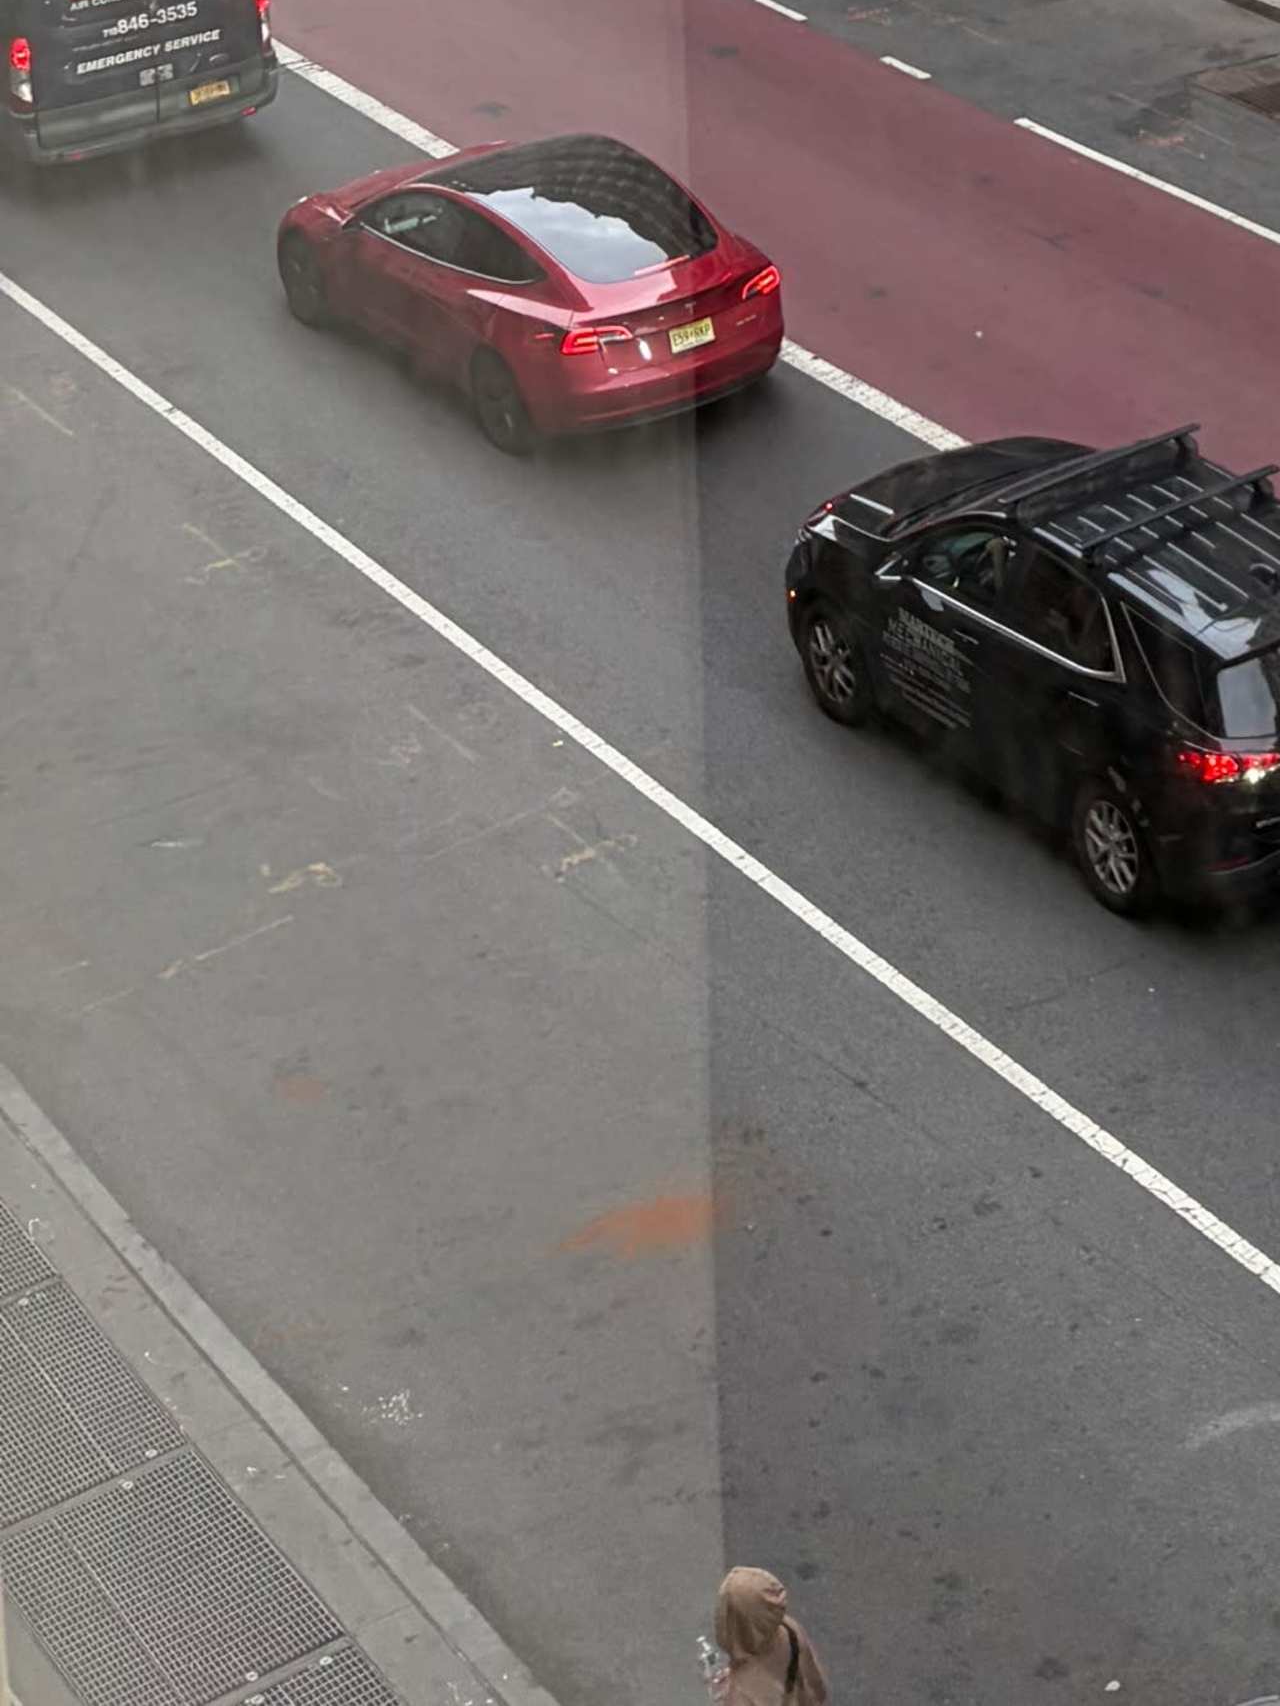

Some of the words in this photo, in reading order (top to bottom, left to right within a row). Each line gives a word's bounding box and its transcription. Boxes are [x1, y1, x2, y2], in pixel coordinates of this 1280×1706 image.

[70, 1, 89, 12] AIR
[76, 44, 161, 75] EMERGENCY
[164, 29, 221, 53] SERVICE
